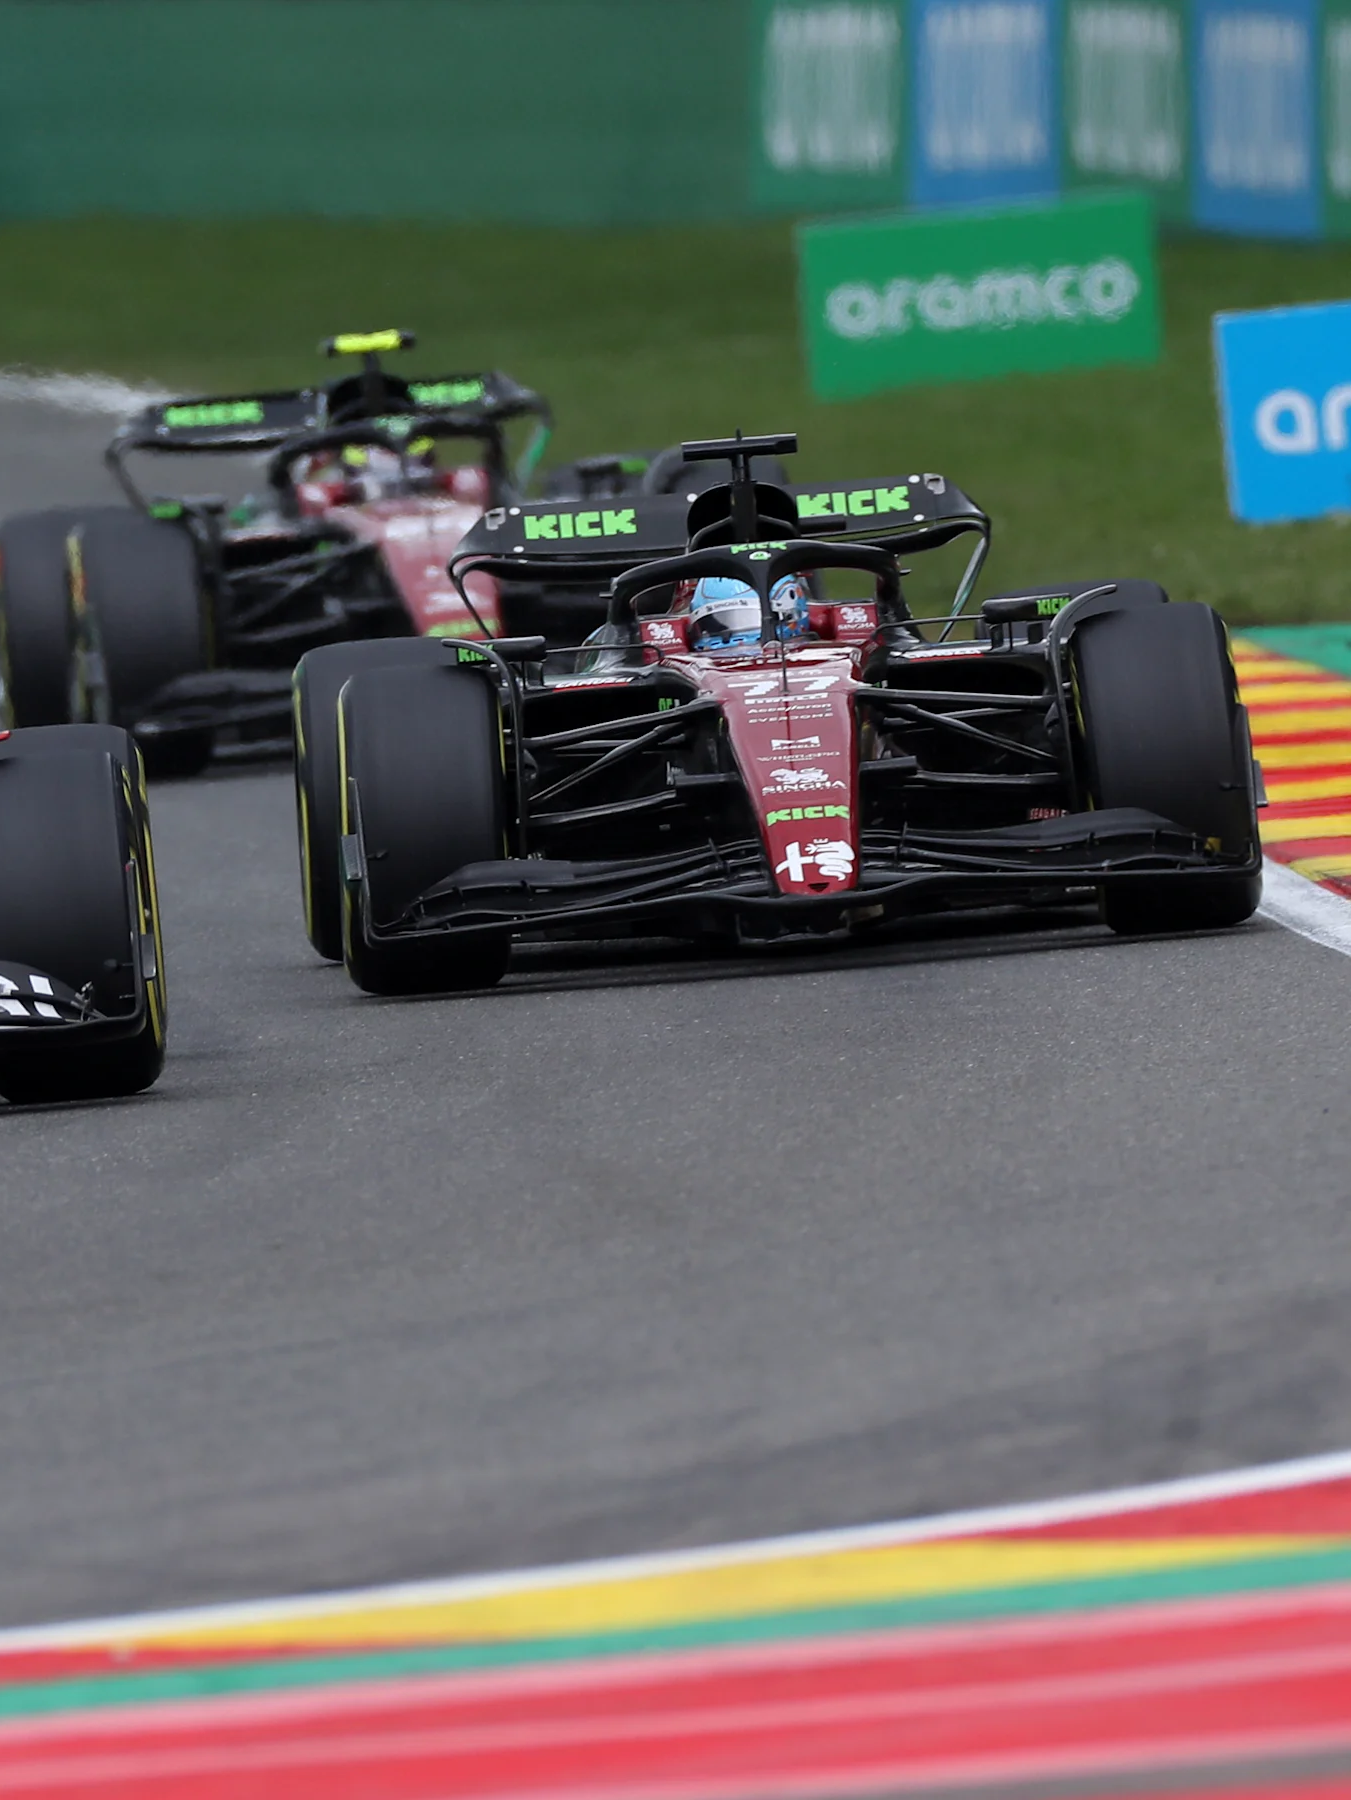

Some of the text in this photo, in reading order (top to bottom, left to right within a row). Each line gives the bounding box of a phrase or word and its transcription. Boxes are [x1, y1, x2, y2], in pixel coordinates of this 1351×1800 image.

[823, 256, 1139, 338] aramco
[795, 485, 911, 517] KICK
[524, 509, 637, 540] KICK
[730, 541, 787, 554] KICK
[727, 676, 840, 697] 77
[762, 780, 848, 793] SINGHA
[766, 804, 850, 827] KICK
